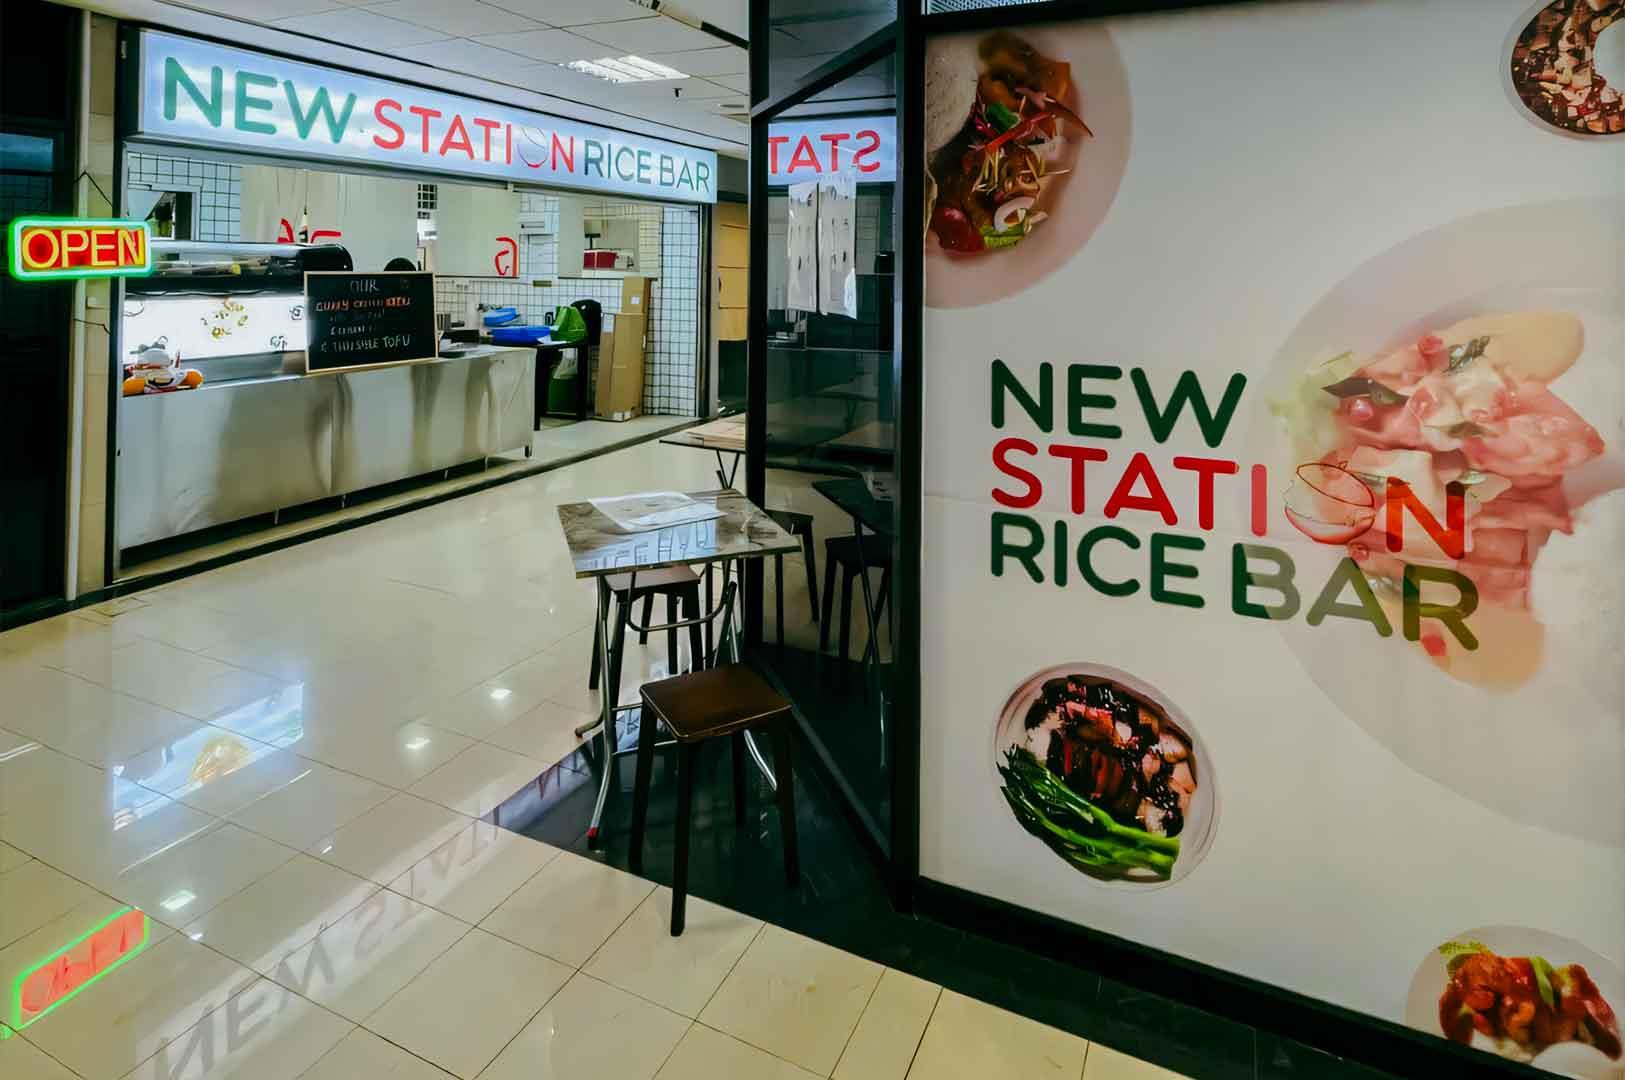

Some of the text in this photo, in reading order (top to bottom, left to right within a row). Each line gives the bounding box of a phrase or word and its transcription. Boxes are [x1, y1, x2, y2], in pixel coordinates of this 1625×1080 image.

[164, 57, 710, 192] NEW STATION RICE BAR
[22, 228, 144, 269] OPEN
[991, 359, 1247, 448] NEW
[991, 437, 1466, 560] STATION
[991, 511, 1479, 651] RICE BAR
